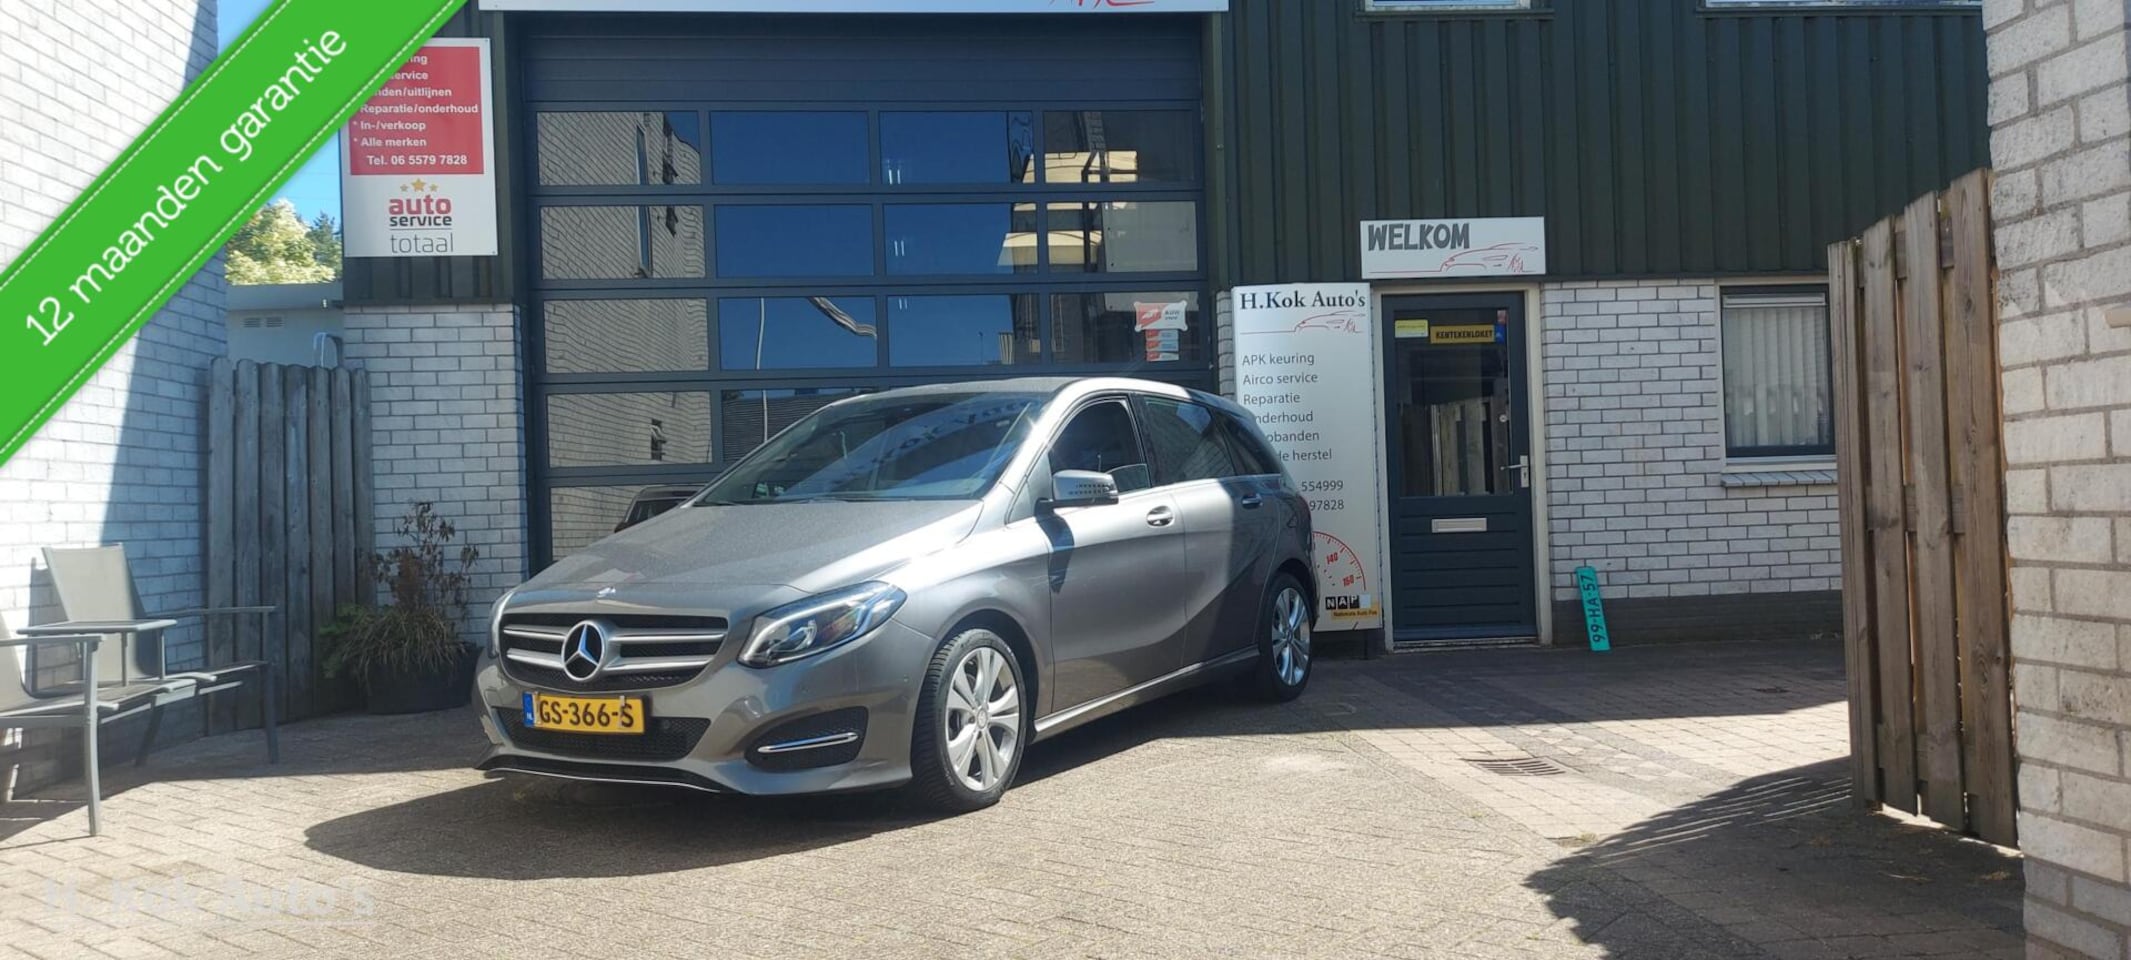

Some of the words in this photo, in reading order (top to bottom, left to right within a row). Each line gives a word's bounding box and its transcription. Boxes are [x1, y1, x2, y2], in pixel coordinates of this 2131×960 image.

[373, 86, 453, 99] nden/uitlijnen
[360, 120, 427, 132] In-/verkoop
[360, 137, 382, 147] Alle
[385, 137, 427, 147] merken
[366, 155, 388, 165] Tel.
[391, 155, 405, 165] 06
[408, 154, 436, 165] 5579
[440, 154, 468, 165] 7828
[388, 194, 453, 215] auto
[389, 215, 453, 227] service
[389, 232, 454, 254] totaal
[1367, 222, 1470, 251] WELKOM
[1239, 290, 1307, 310] H.Kok
[1311, 289, 1366, 308] Auto's
[1242, 354, 1266, 366] APK
[1269, 352, 1315, 366] keuring
[1242, 374, 1274, 385] Airco
[1277, 372, 1319, 384] service
[1243, 392, 1301, 407] Reparatie
[1255, 411, 1314, 424] nderhoud
[1266, 430, 1320, 443] obanden
[1292, 448, 1333, 461] herstel
[1309, 499, 1345, 511] 97828
[539, 699, 635, 728] GS-366-S
